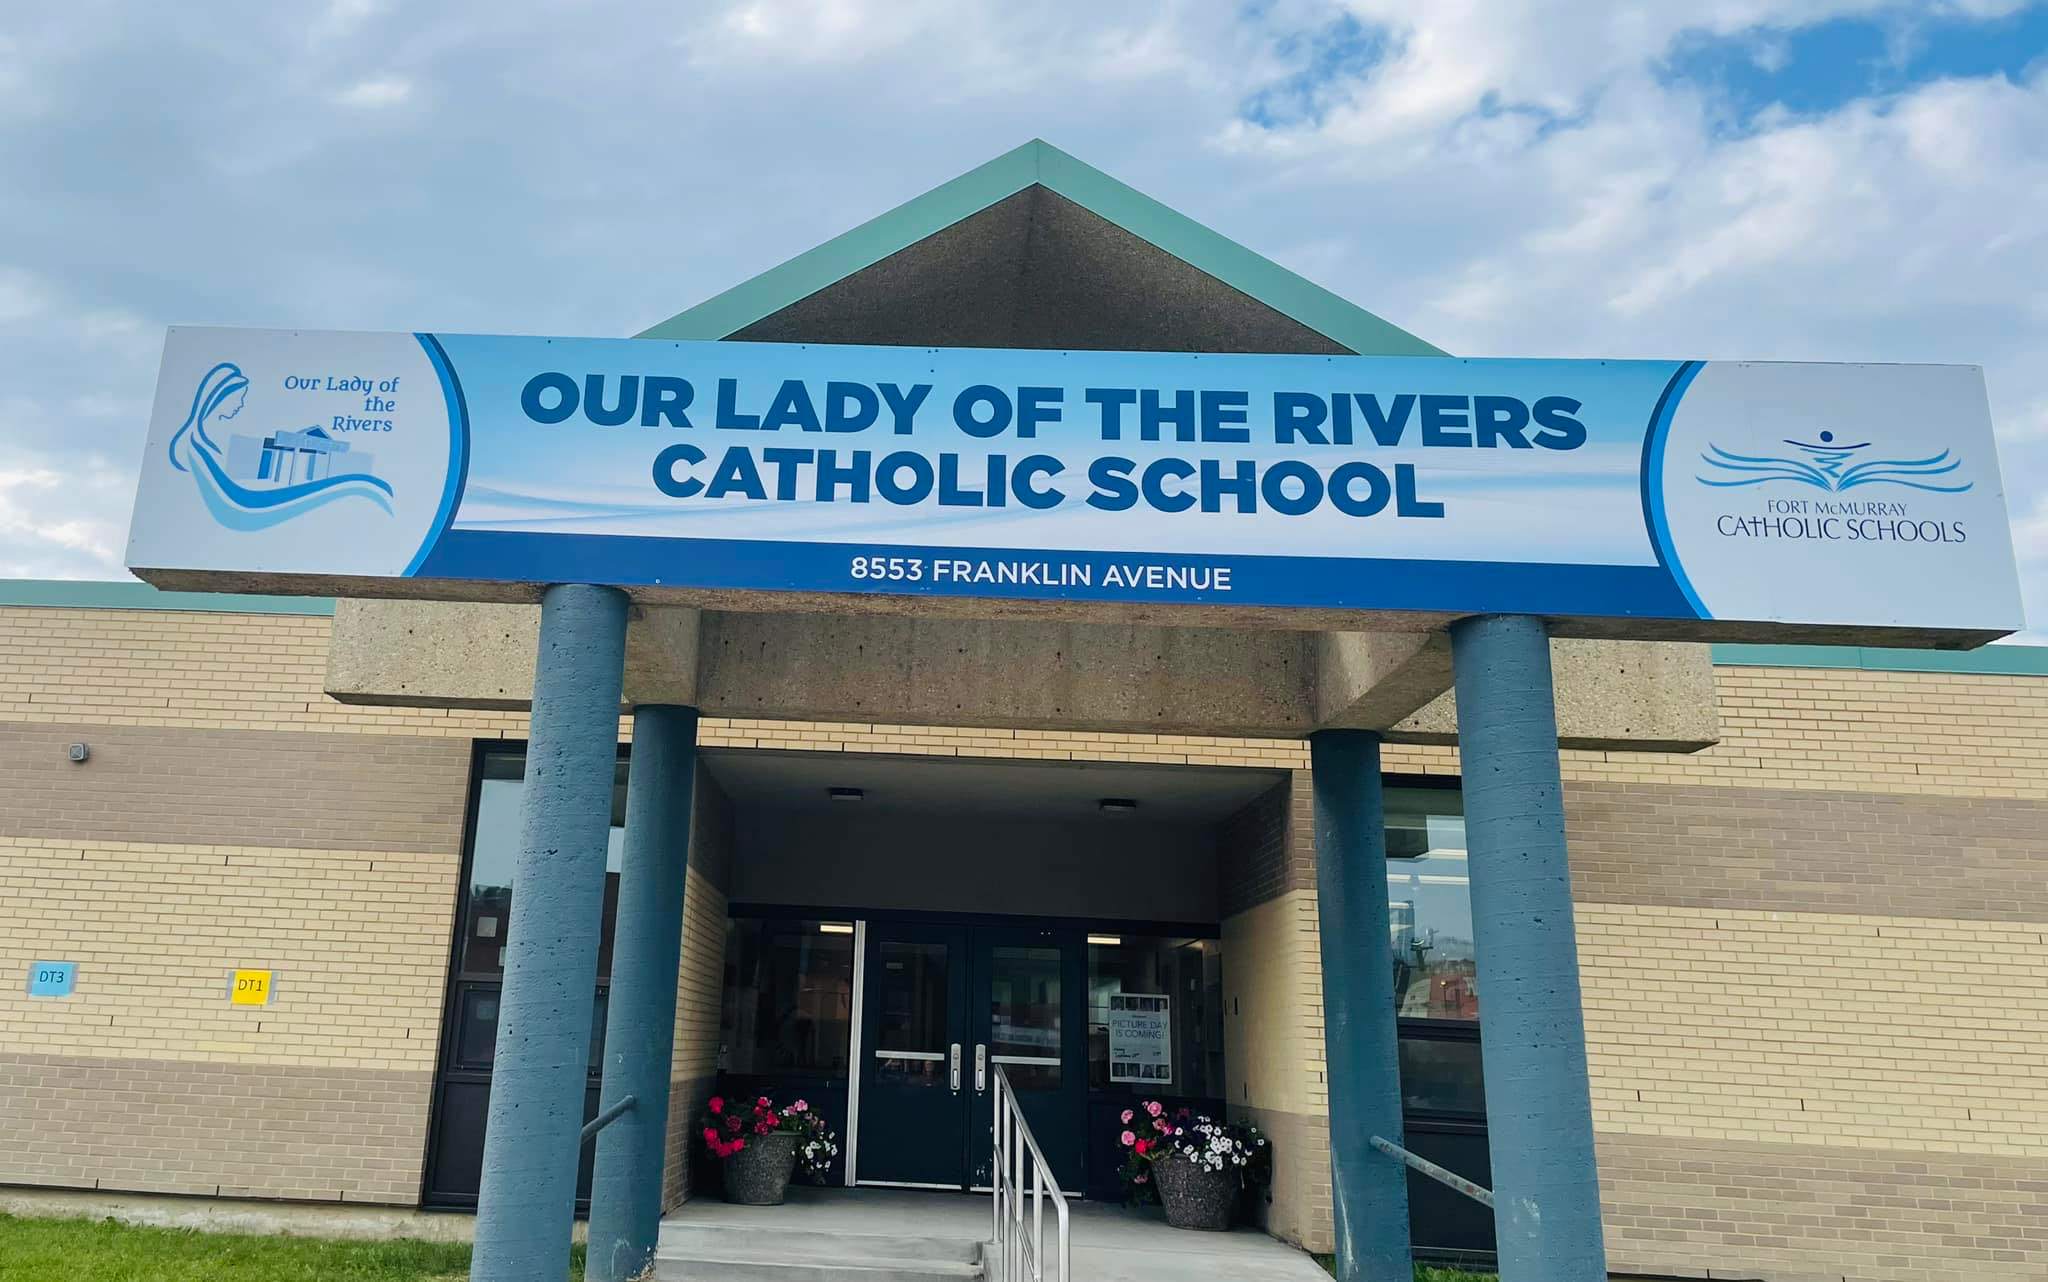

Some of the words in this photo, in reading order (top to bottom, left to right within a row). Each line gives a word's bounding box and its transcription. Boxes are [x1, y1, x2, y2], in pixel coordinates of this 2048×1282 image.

[284, 375, 321, 391] Our
[326, 376, 374, 397] Lady
[379, 377, 401, 393] of
[364, 396, 396, 412] the
[521, 371, 695, 429] OUR
[715, 378, 935, 435] LADY
[952, 384, 1064, 439] OF
[1085, 387, 1251, 444] THE
[1273, 391, 1587, 451] RIVERS
[332, 415, 394, 433] Rivers
[652, 443, 1066, 510] CATHOLIC
[1085, 456, 1445, 519] SCHOOL
[1767, 499, 1809, 515] FORT
[1815, 500, 1907, 517] McMURRAY
[1847, 518, 1967, 544] SCHOOLS
[851, 556, 924, 581] 8553
[933, 559, 1092, 587] FRANKLIN
[1102, 564, 1233, 591] AVENUE
[39, 970, 65, 984] DT3
[238, 978, 264, 992] DT1
[1112, 1019, 1147, 1029] PICTURE
[1150, 1020, 1168, 1030] DAY
[1115, 1029, 1123, 1038] IS
